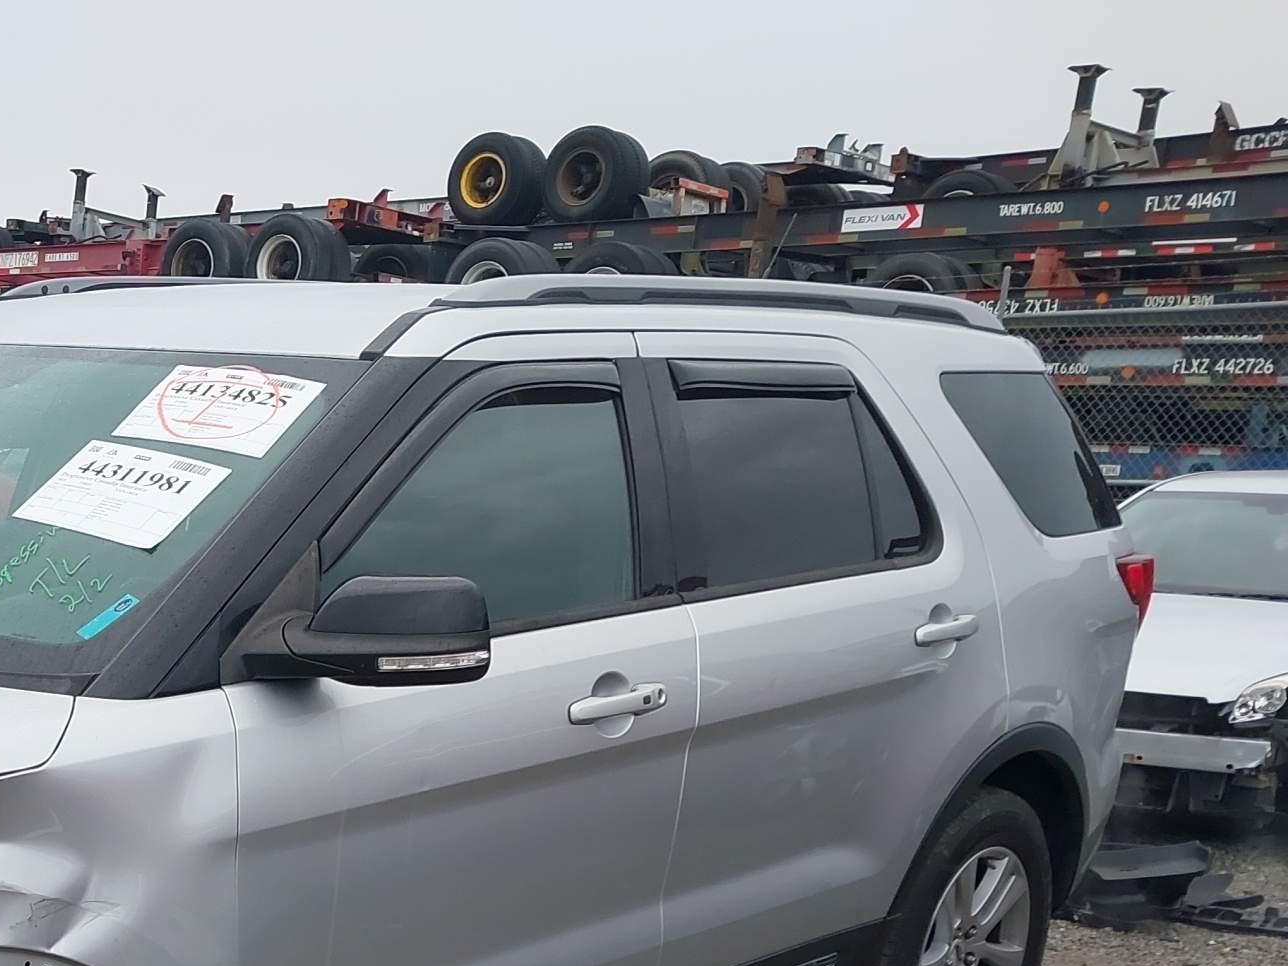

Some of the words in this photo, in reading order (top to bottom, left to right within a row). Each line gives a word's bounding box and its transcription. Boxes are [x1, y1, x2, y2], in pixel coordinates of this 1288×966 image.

[1144, 194, 1183, 212] FLXZ
[1186, 190, 1237, 209] 414671
[844, 215, 879, 225] FLEXI
[881, 212, 907, 222] VAN
[1172, 358, 1210, 374] FLXZ
[1214, 358, 1274, 374] 442726
[170, 382, 294, 408] 44134825
[77, 459, 193, 494] 44311981
